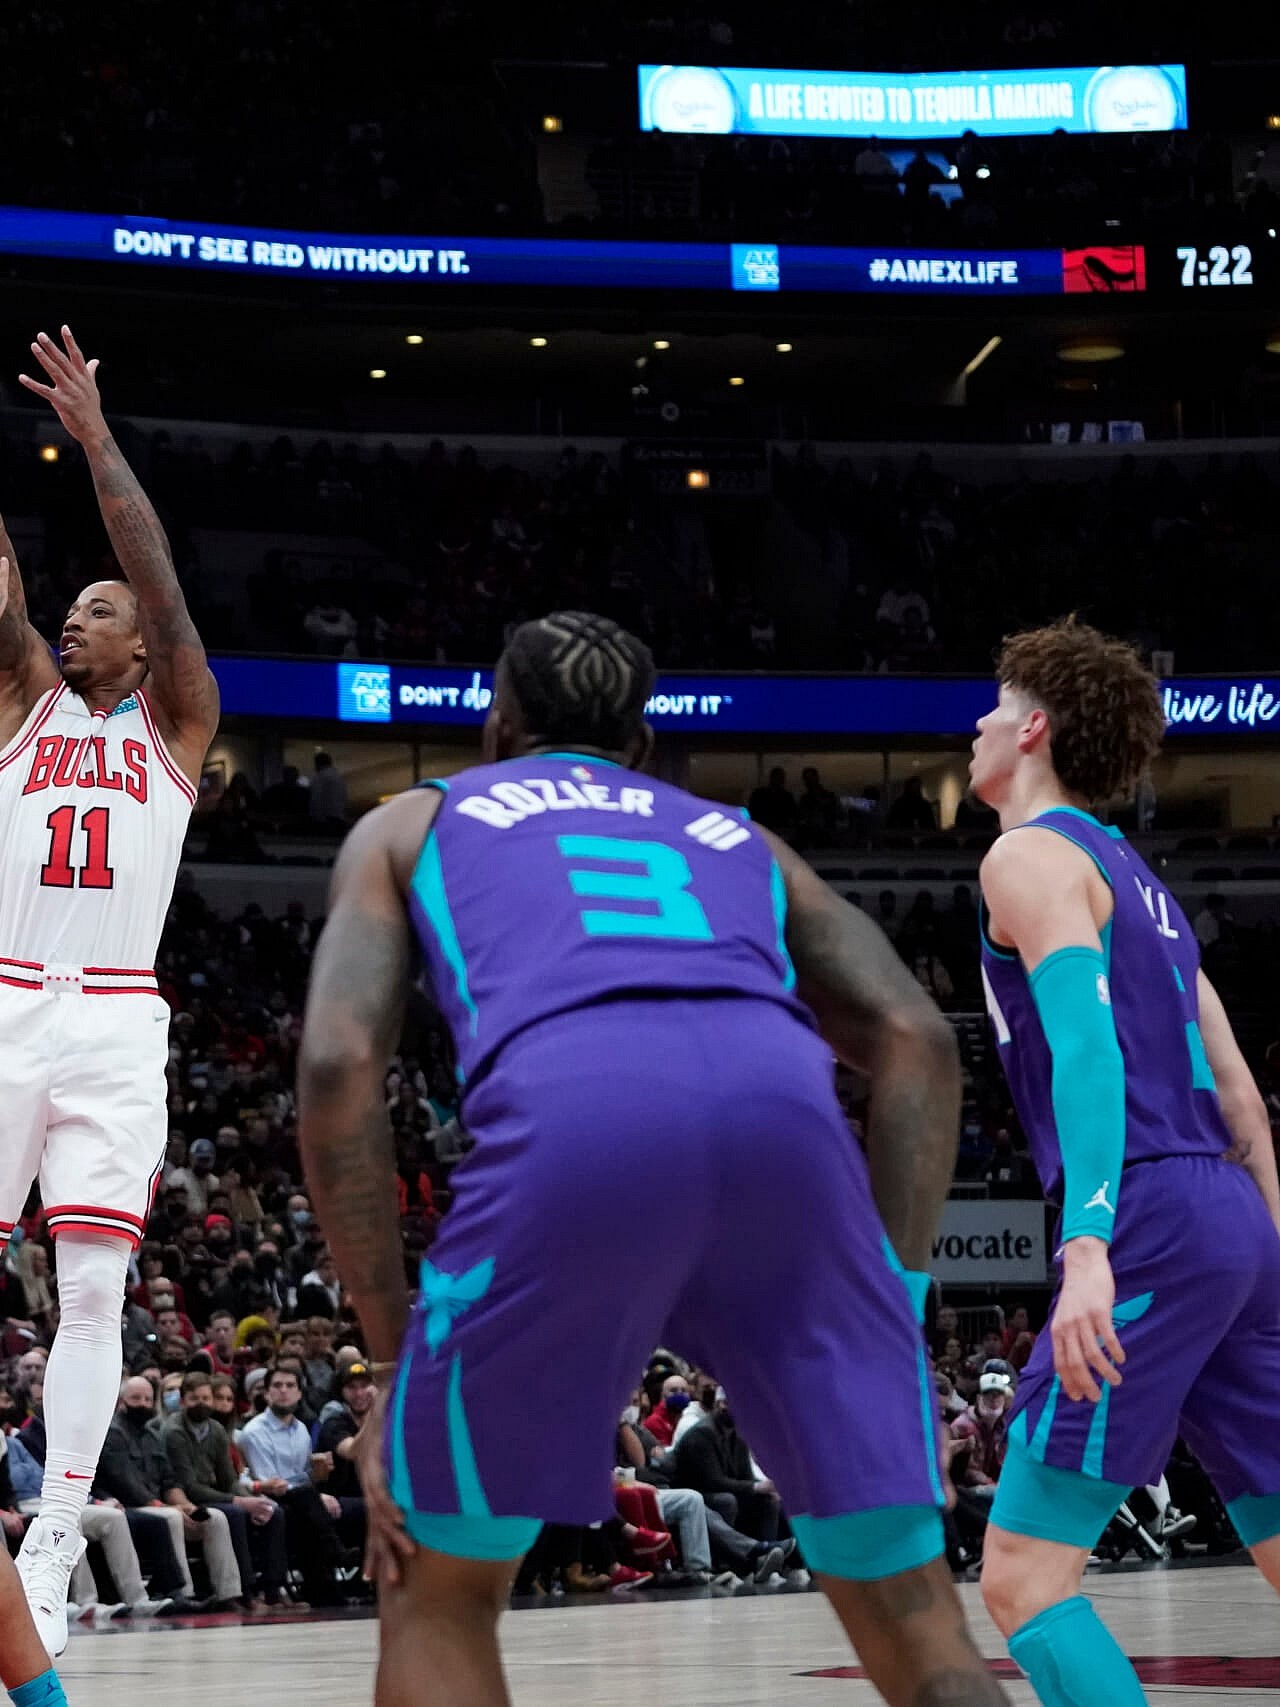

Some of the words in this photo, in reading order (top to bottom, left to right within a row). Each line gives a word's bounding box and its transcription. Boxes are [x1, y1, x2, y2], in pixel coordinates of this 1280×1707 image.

[751, 83, 762, 118] A
[766, 84, 800, 119] LIFE
[804, 85, 884, 121] DEVOTED
[888, 88, 911, 122] TO
[914, 86, 991, 124] TEQUILA
[995, 82, 1073, 119] MAKING
[113, 229, 194, 259] DON'T
[198, 236, 248, 264] SEE
[252, 241, 304, 268] RED
[307, 245, 433, 274] WITHOUT
[438, 250, 470, 274] IT.
[869, 258, 1018, 284] #AMEXLIFE
[1177, 246, 1253, 287] 7:22
[399, 684, 459, 708] DON'T
[462, 672, 493, 712] do
[1163, 688, 1223, 727] live
[1228, 683, 1280, 727] life
[22, 734, 148, 805] BULLS
[455, 779, 655, 829] ROZIER
[40, 805, 114, 890] 11
[556, 834, 715, 942] 3
[931, 1229, 1033, 1260] vocate
